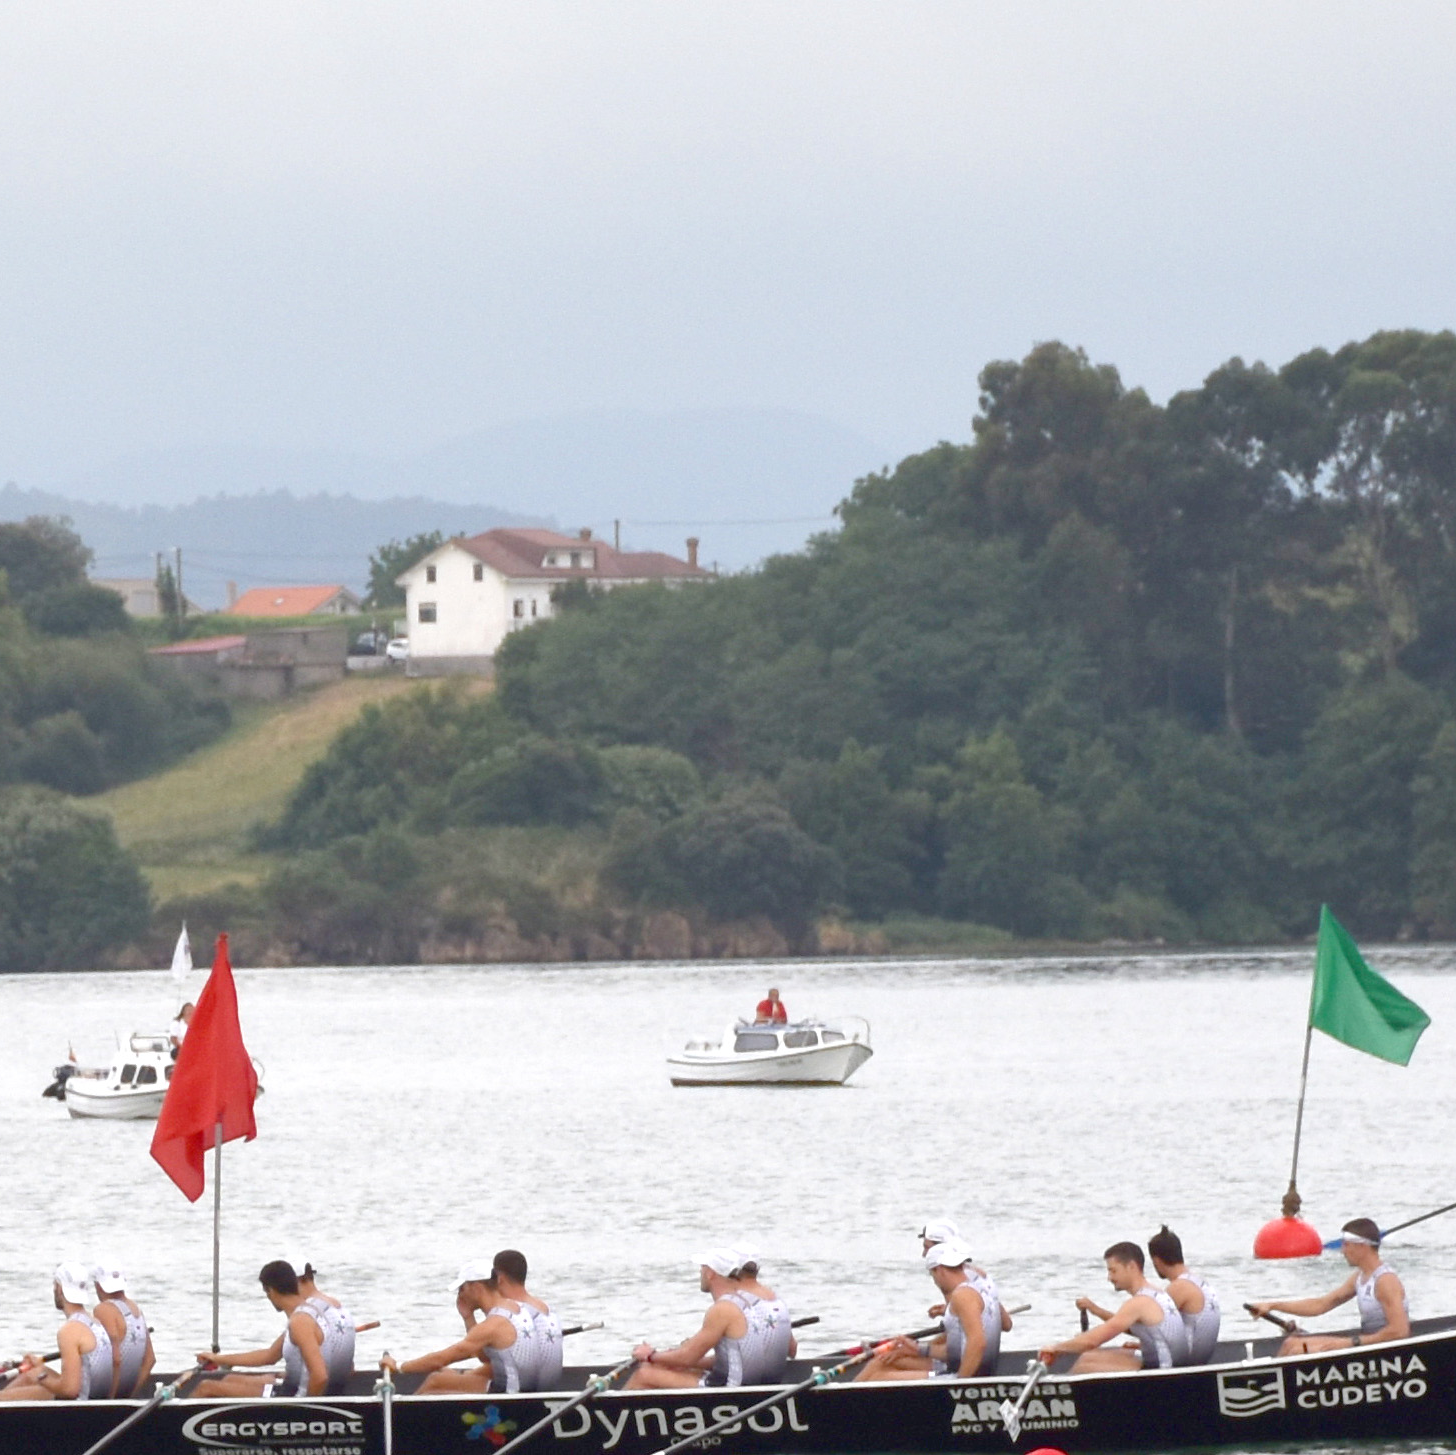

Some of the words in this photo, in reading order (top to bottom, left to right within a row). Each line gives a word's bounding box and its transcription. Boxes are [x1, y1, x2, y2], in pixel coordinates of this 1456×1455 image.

[1295, 1354, 1428, 1386] MARINA
[1297, 1378, 1428, 1409] CUDEYO
[544, 1396, 810, 1449] Dynasol
[951, 1399, 1077, 1423] ARAN
